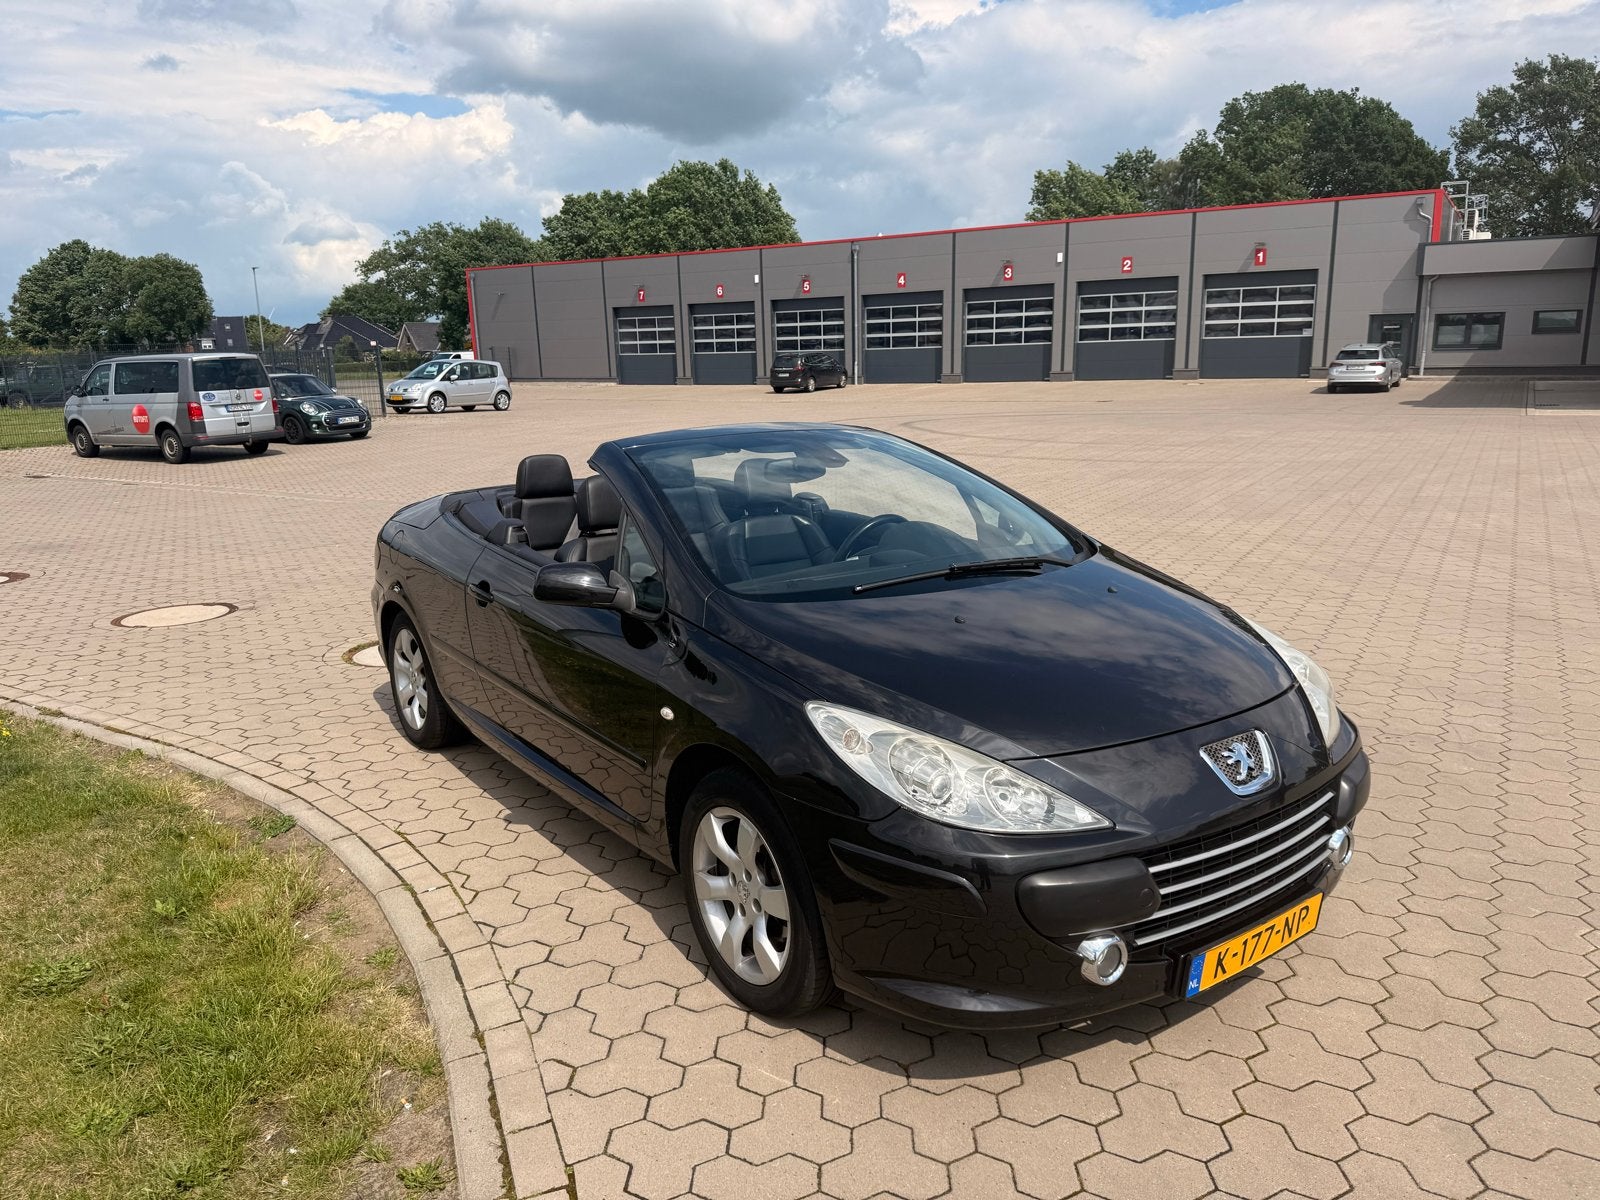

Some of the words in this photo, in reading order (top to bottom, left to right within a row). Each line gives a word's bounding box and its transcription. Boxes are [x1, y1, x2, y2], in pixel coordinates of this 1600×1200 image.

[1257, 251, 1264, 263] 1
[1123, 259, 1132, 271] 2
[1004, 268, 1012, 278] 3
[898, 275, 905, 285] 4
[803, 281, 810, 291] 5
[639, 291, 645, 300] 7
[717, 287, 723, 296] 6
[1213, 905, 1310, 979] K-177-NP
[1188, 978, 1199, 990] NL
